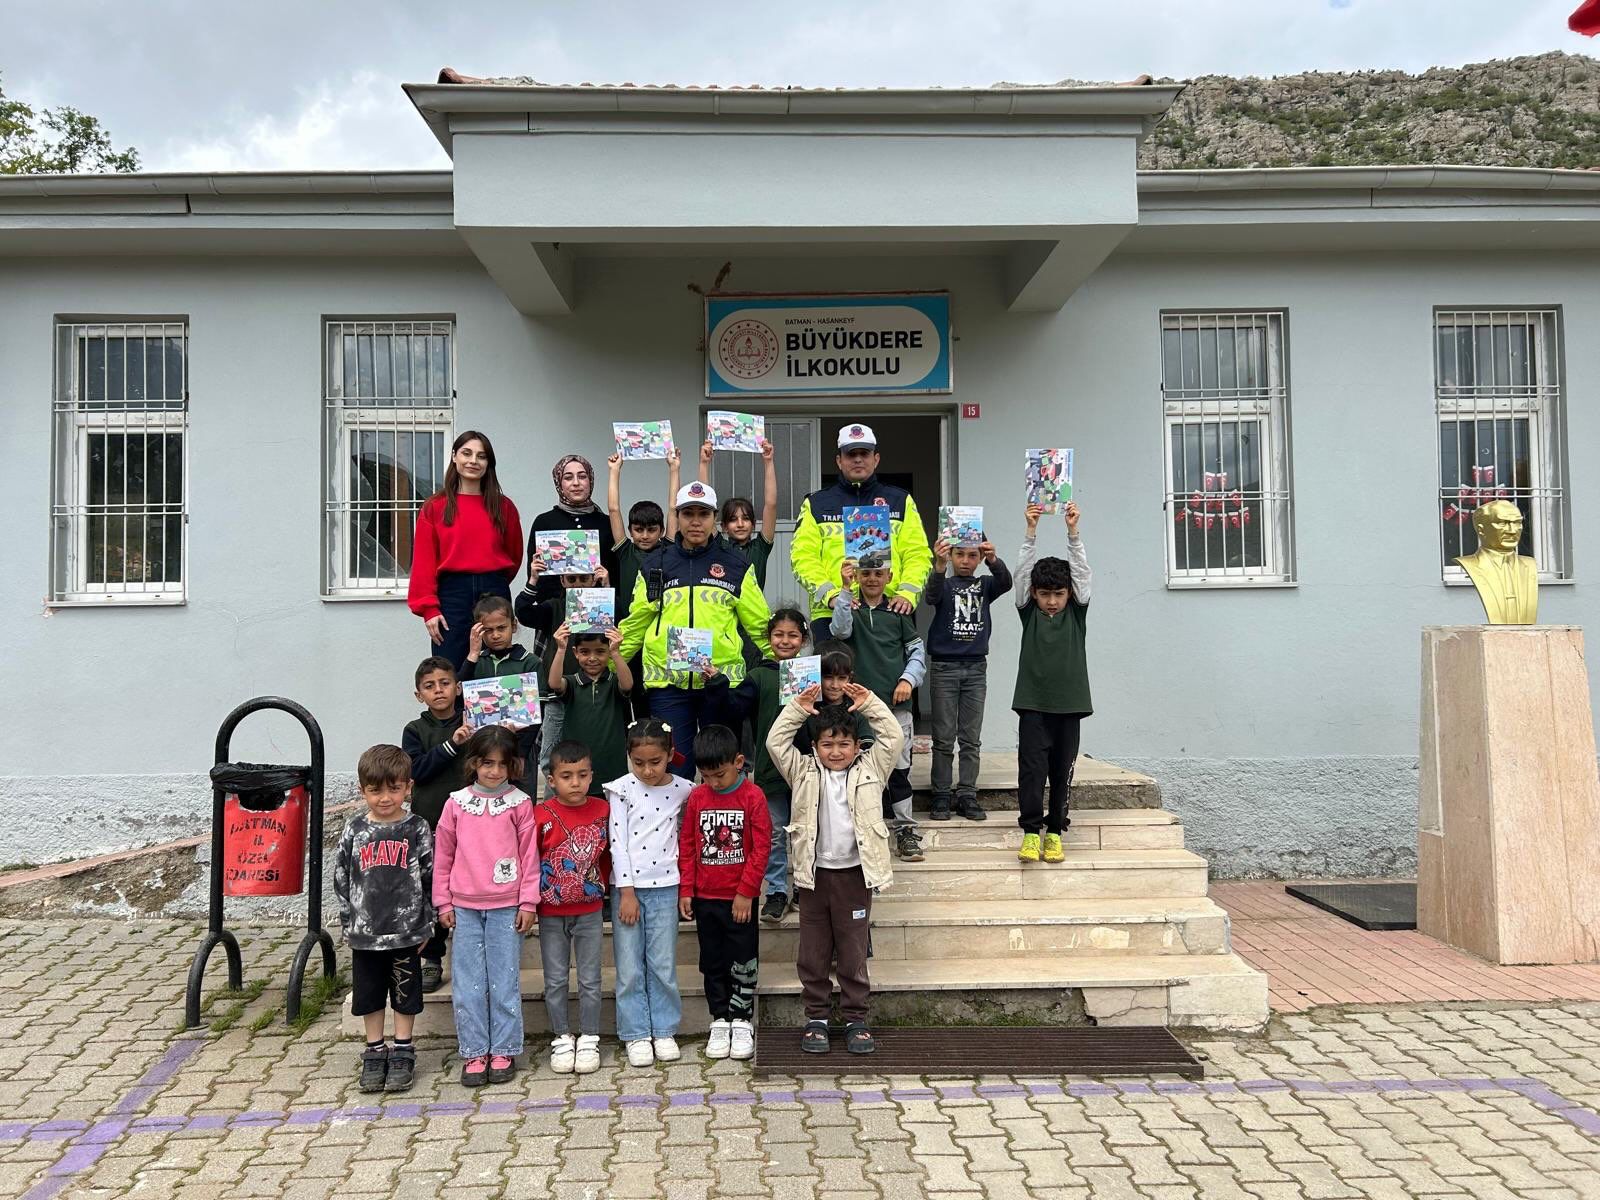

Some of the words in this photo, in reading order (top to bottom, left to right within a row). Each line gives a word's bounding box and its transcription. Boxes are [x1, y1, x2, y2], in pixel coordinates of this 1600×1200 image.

[785, 318, 812, 326] BATMAN
[817, 317, 855, 325] HASANKEYF
[786, 327, 923, 351] BÜYÜKDERE
[787, 354, 900, 377] İLKOKULU
[968, 406, 976, 416] 15
[700, 813, 744, 826] POWER
[360, 838, 409, 871] MAVİ
[717, 848, 744, 858] GREAT
